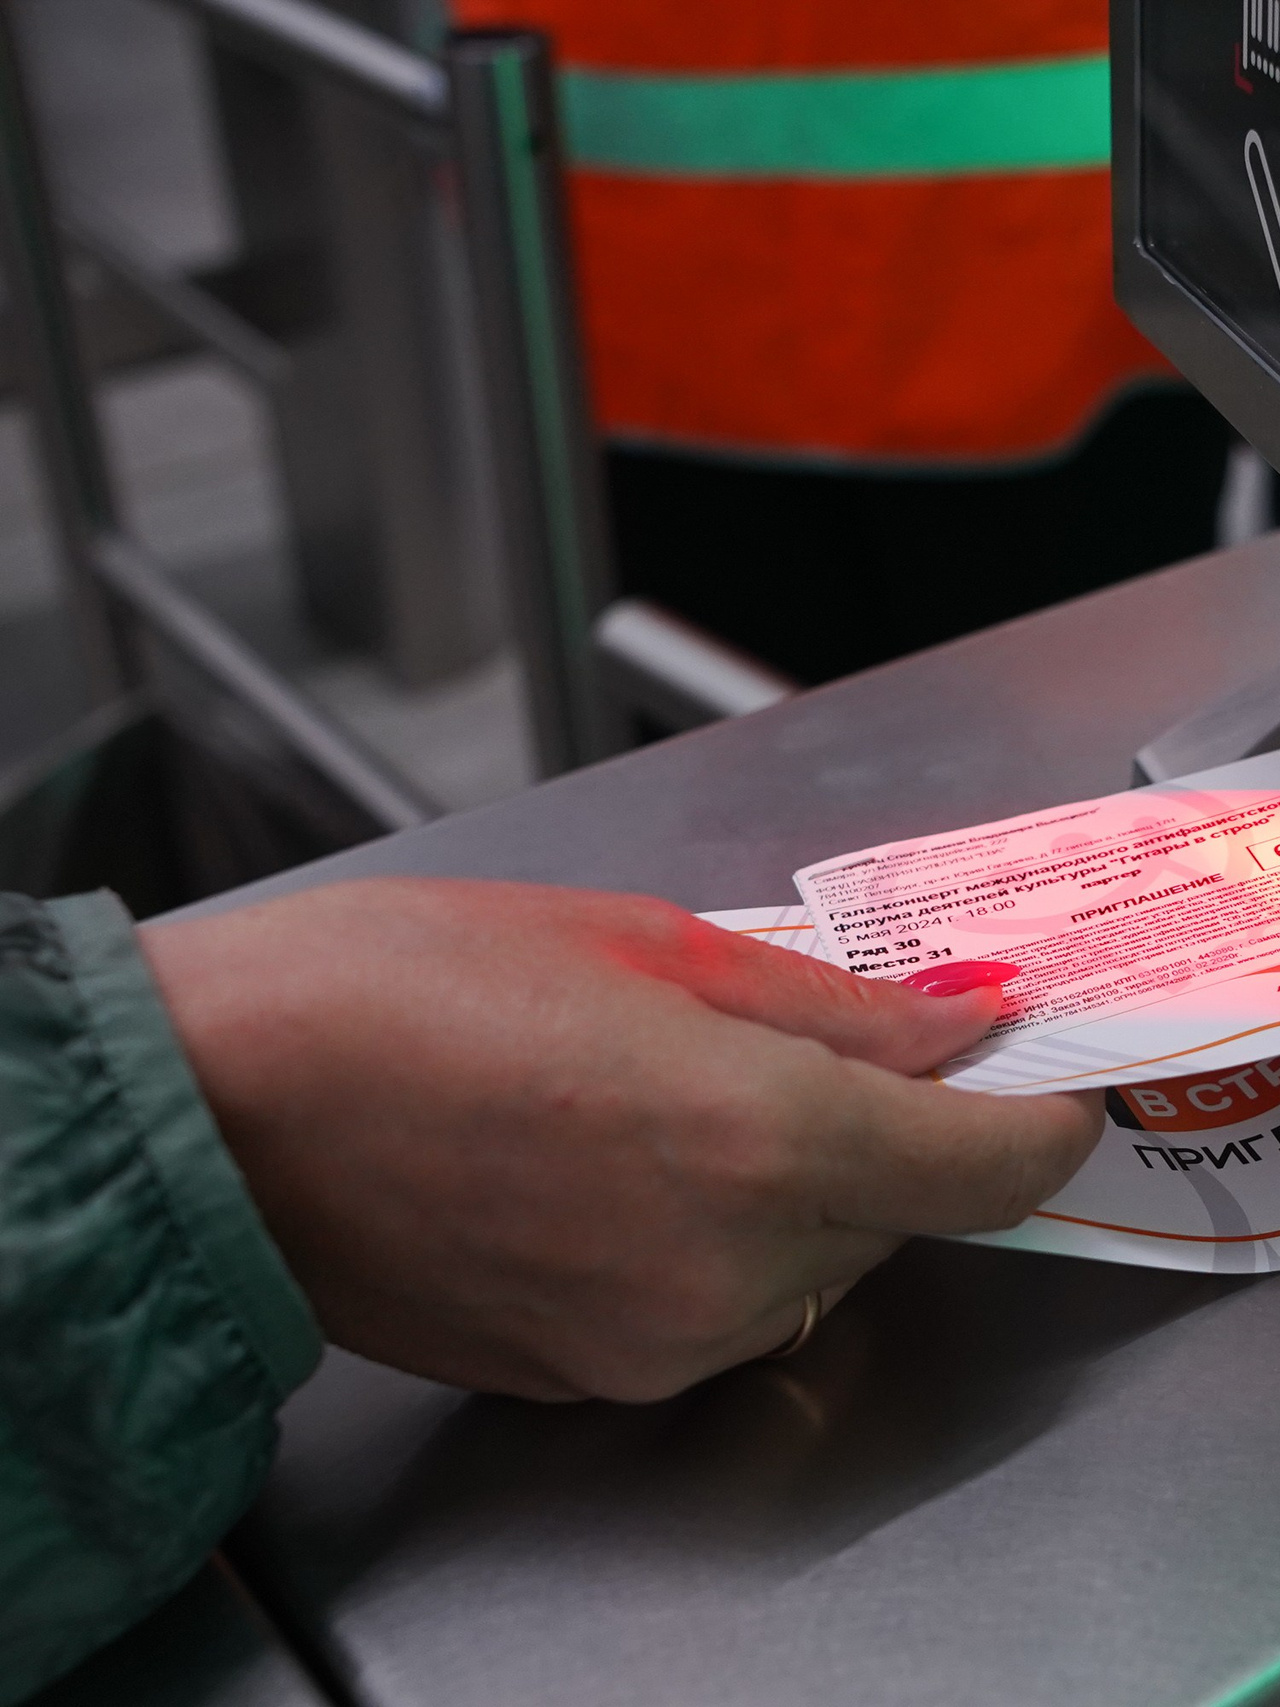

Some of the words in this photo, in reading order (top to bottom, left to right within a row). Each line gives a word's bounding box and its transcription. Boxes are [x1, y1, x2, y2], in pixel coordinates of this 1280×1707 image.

[828, 887, 959, 928] Гала-концерт
[965, 846, 1132, 891] международного
[833, 911, 912, 939] форума
[918, 888, 1009, 917] деятелей
[1014, 864, 1107, 892] культуры
[1109, 840, 1190, 864] "Гитары
[1207, 813, 1275, 838] строю"
[1080, 869, 1141, 889] партер
[1070, 873, 1224, 923] ПРИГЛАШЕНИЕ
[838, 935, 849, 944] 5
[856, 929, 891, 941] мая
[895, 916, 942, 933] 2024
[946, 915, 958, 923] г.
[965, 899, 1015, 917] 18:00
[990, 936, 1055, 956] Мероприятия
[1057, 914, 1137, 938] антироссийскую
[846, 946, 889, 959] Ряд
[893, 938, 921, 950] 30
[848, 956, 920, 973] Место
[926, 947, 952, 959] 31
[993, 950, 1028, 961] ельное
[1012, 955, 1039, 963] ения,
[990, 1017, 1026, 1030] секция
[1050, 1001, 1080, 1013] Заказ
[1123, 978, 1155, 990] тираж
[1156, 972, 1170, 980] 90
[1002, 986, 1044, 1002] ржащей
[1023, 1001, 1048, 1013] ИНН
[1050, 982, 1112, 1005] 6316240948
[1113, 975, 1136, 986] КПП
[1043, 1014, 1062, 1022] ИНН
[1113, 991, 1136, 1001] ОГРН
[1130, 1088, 1178, 1118] В
